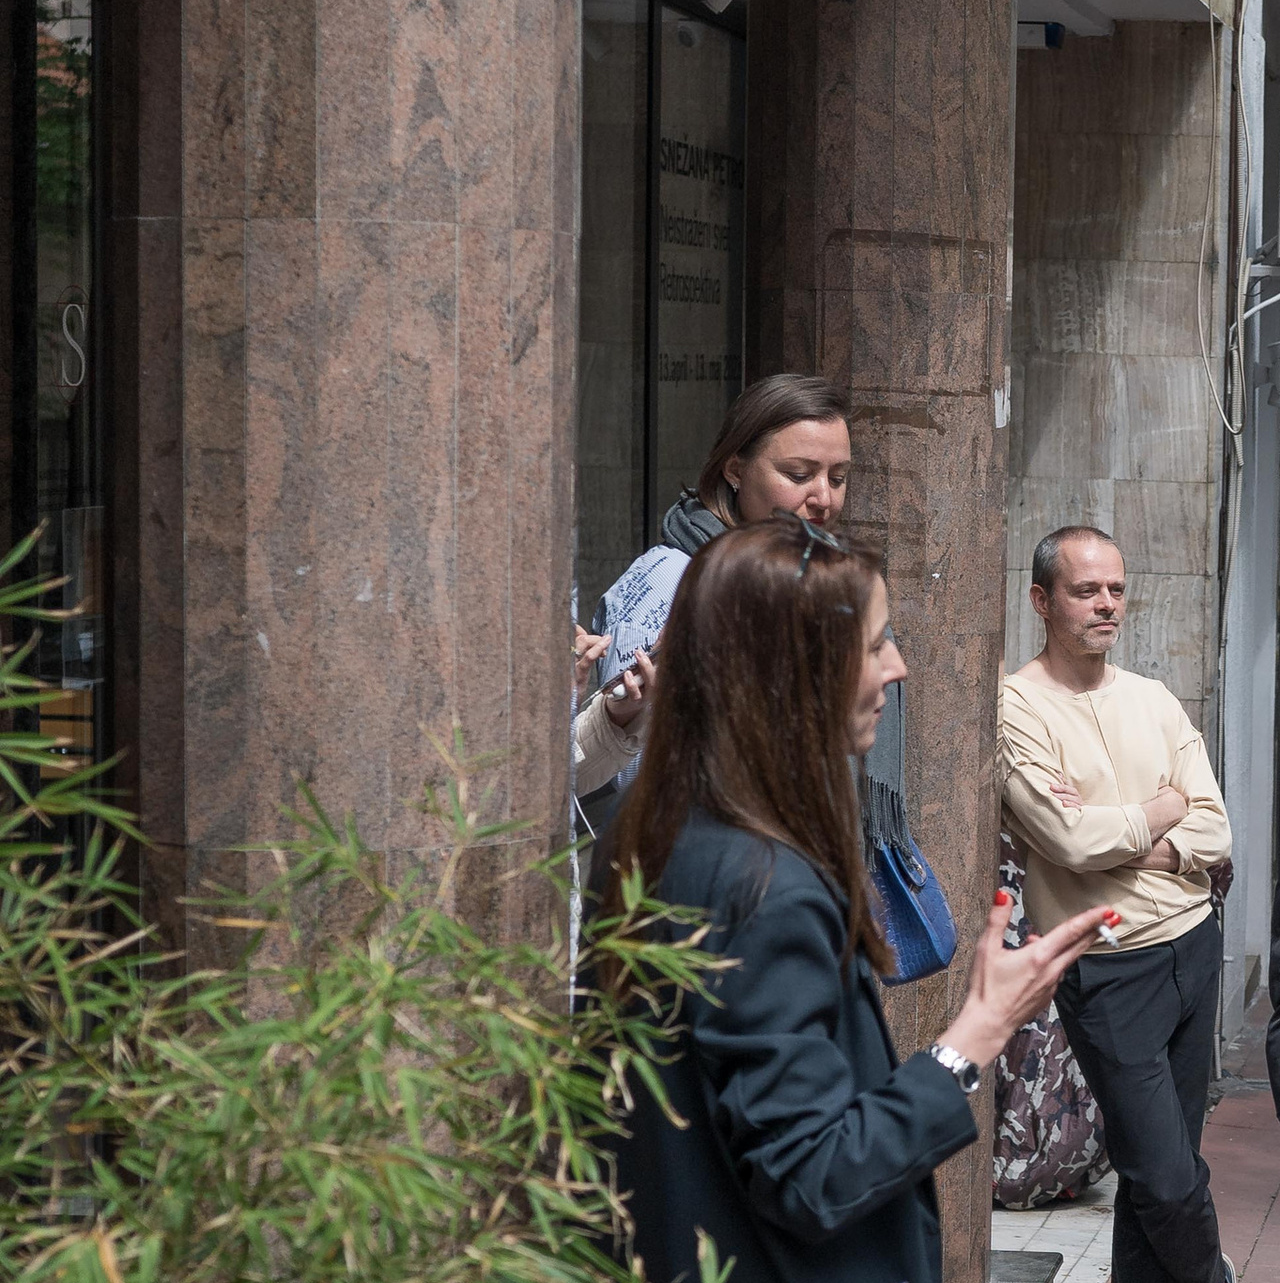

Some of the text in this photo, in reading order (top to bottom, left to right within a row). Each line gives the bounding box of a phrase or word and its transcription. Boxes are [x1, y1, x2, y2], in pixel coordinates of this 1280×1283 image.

[660, 132, 709, 181] SNEŽANA
[659, 204, 711, 248] Neistraženi
[659, 262, 721, 309] Retrospektiva
[62, 303, 86, 387] S
